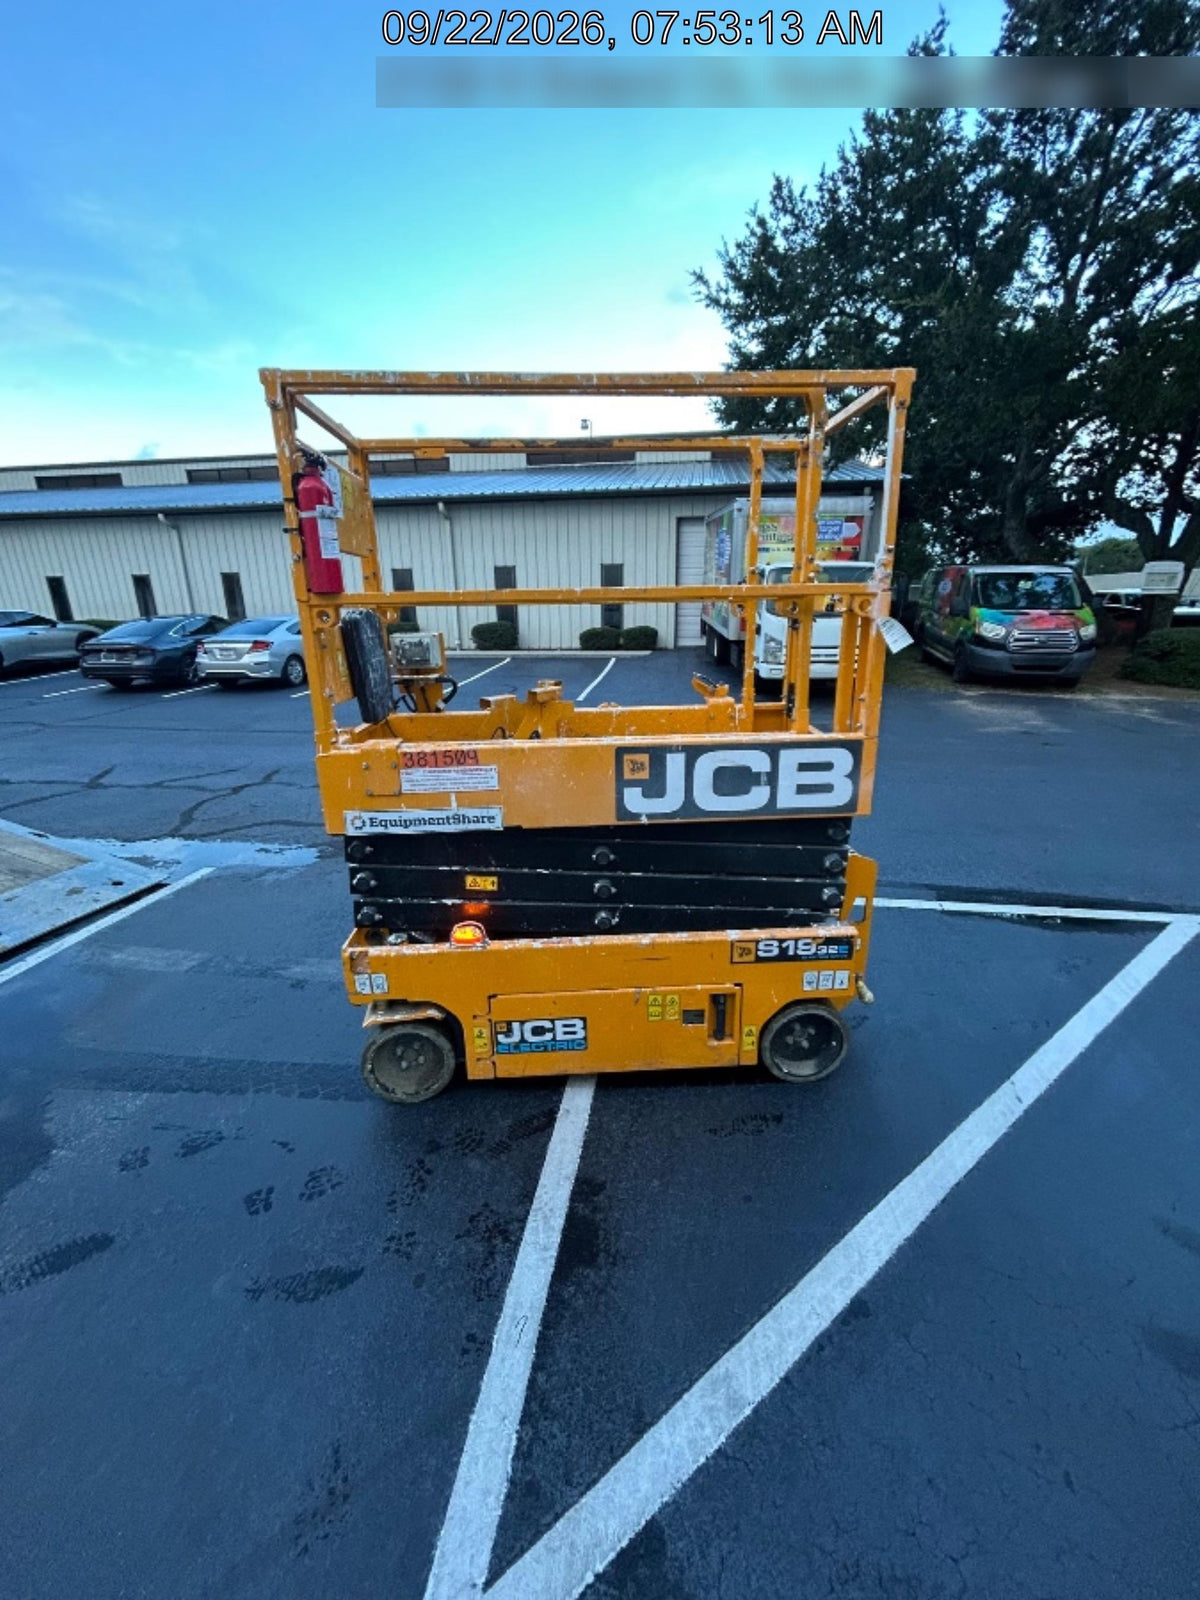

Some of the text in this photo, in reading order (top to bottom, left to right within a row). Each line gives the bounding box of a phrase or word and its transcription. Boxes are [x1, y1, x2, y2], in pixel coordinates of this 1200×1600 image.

[403, 749, 479, 769] 381509
[623, 748, 854, 814] JCB
[368, 814, 496, 830] EquipmentShare
[497, 1018, 586, 1044] JCB
[496, 1039, 587, 1053] ELECTRIC
